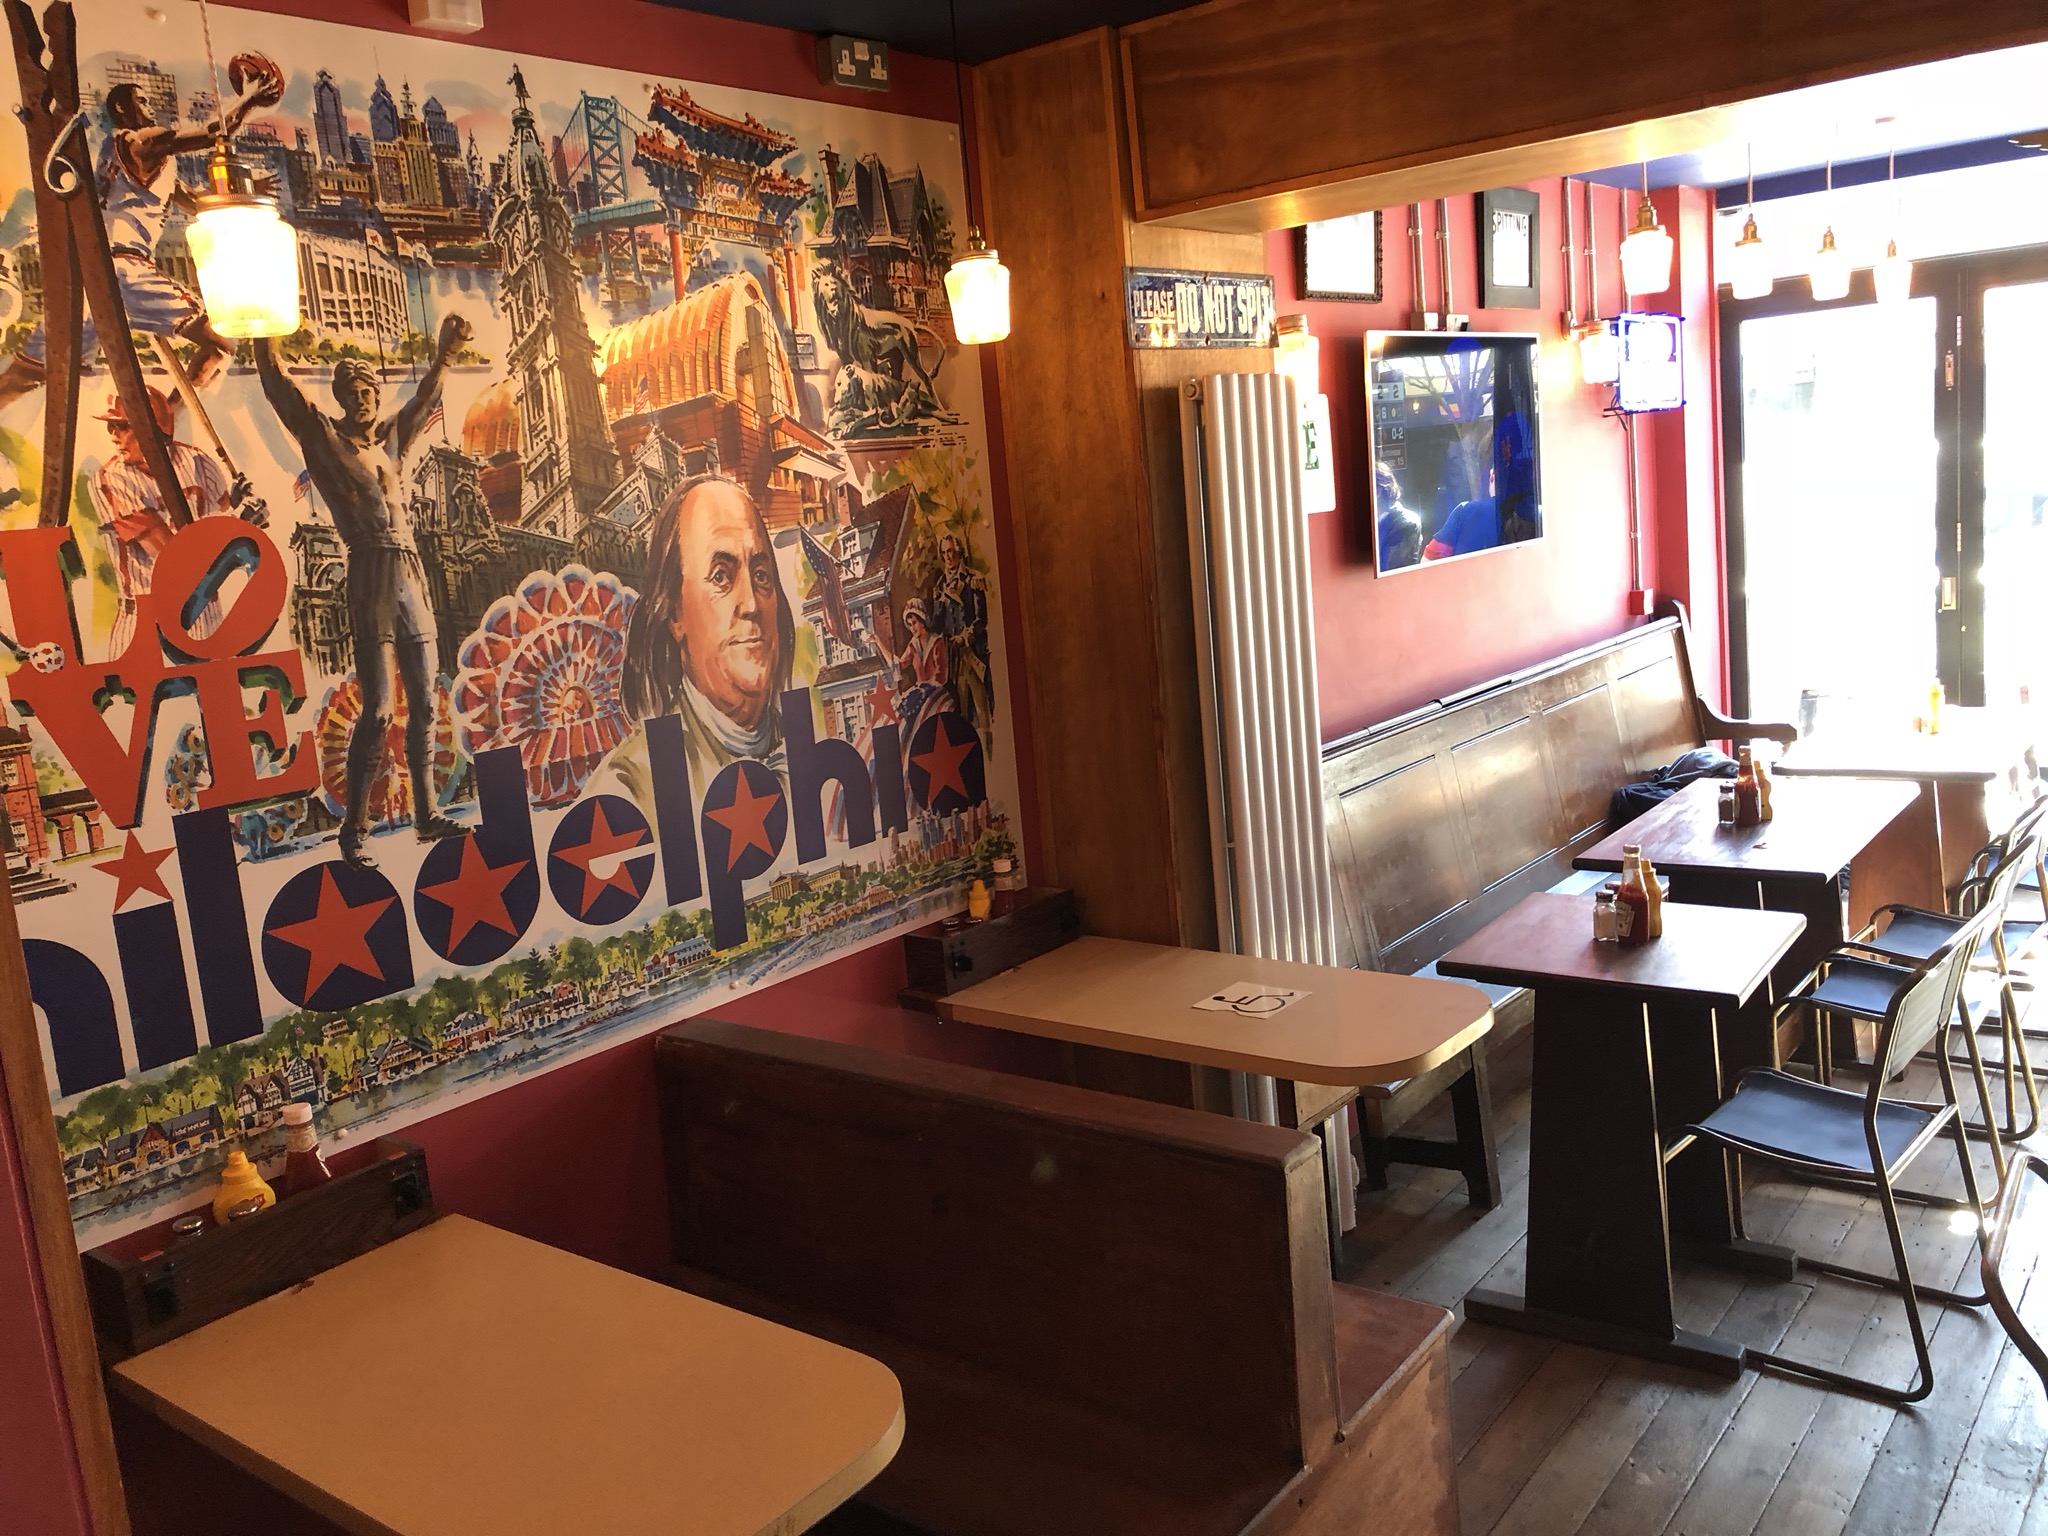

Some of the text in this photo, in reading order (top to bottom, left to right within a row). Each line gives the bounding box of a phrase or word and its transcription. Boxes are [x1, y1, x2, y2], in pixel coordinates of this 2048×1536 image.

[1492, 212, 1527, 236] SPITTING
[1133, 282, 1270, 335] PLEASE DO NOT SPIT
[1392, 384, 1399, 399] 2
